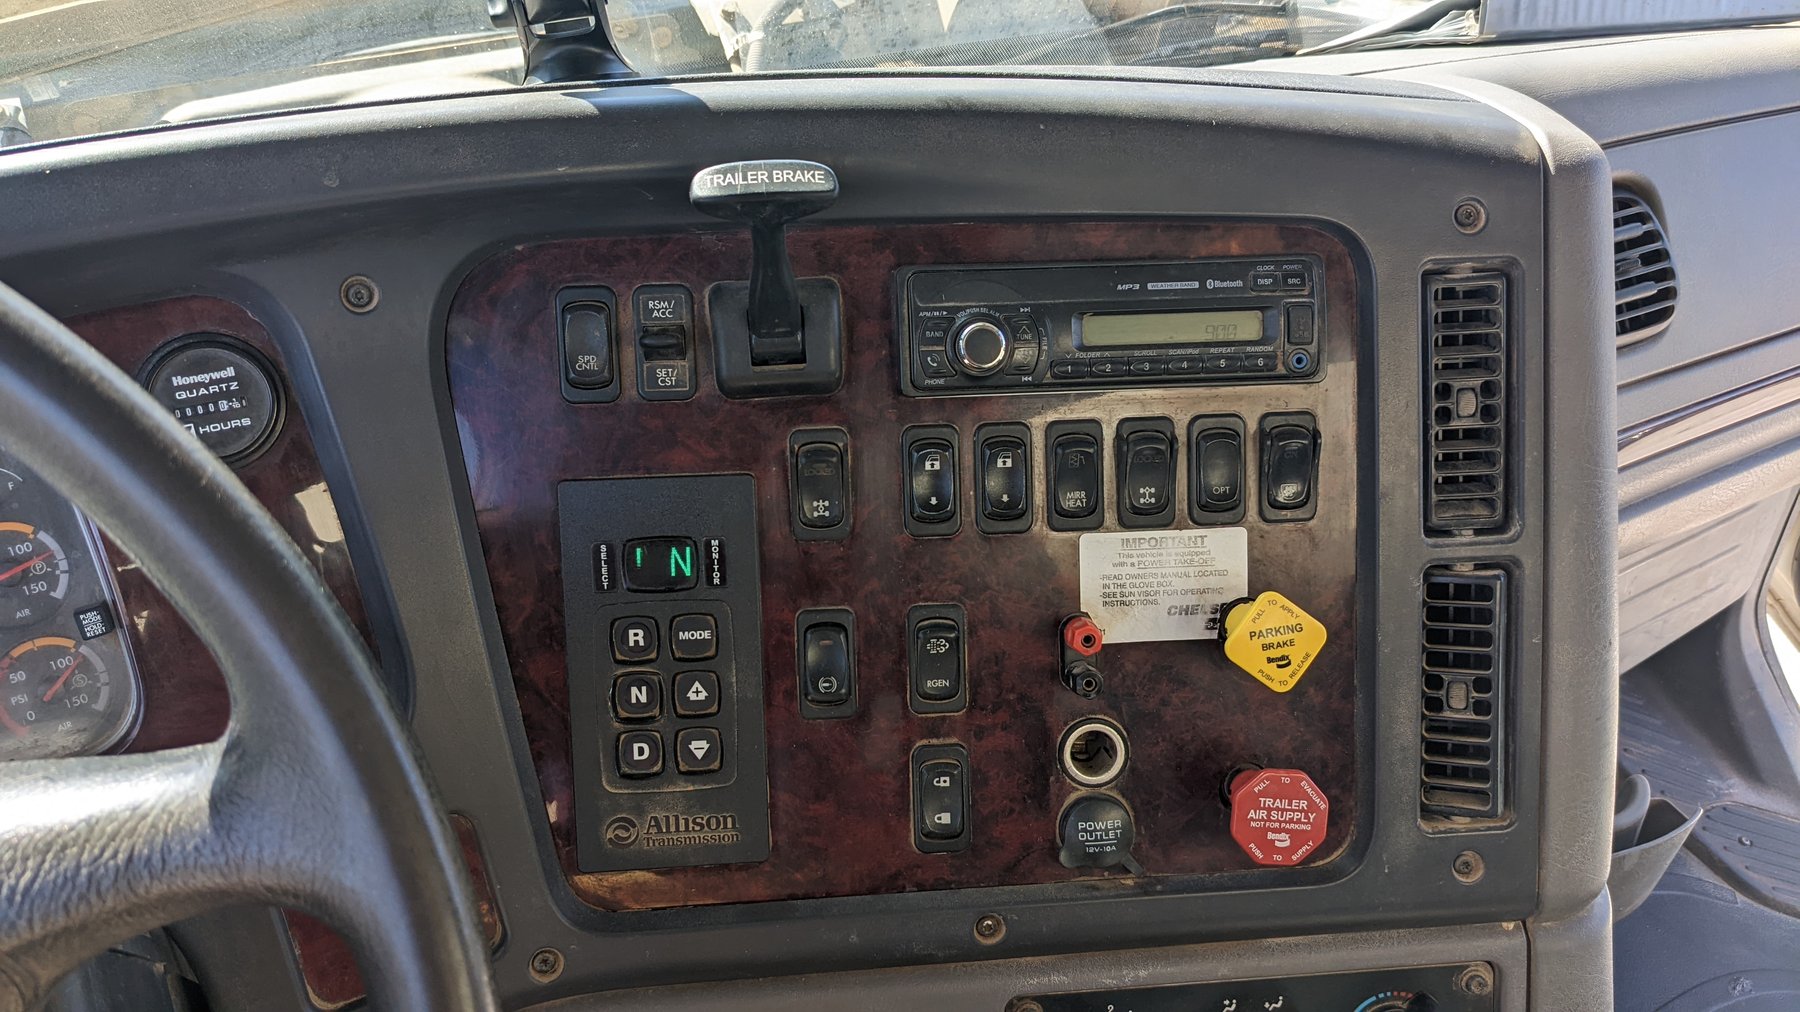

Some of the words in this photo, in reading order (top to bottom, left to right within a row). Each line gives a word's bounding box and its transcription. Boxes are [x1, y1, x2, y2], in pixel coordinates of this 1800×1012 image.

[705, 171, 769, 188] TRAILER
[773, 170, 826, 184] BRAKE
[1116, 283, 1140, 291] MP3
[1180, 281, 1197, 289] BAND
[1214, 279, 1244, 288] Bluetooth
[1257, 278, 1273, 286] DISP
[1287, 277, 1301, 286] SRC
[649, 300, 675, 310] RSM/
[652, 309, 674, 318] ACC
[578, 355, 597, 363] SPD
[1220, 359, 1226, 367] 5
[1257, 358, 1264, 366] 6
[576, 362, 599, 371] CNTL
[1067, 365, 1072, 373] 1
[1105, 364, 1111, 372] 2
[1143, 362, 1149, 370] 3
[1181, 361, 1187, 369] 4
[172, 366, 236, 386] Honeywell
[656, 368, 677, 378] SET/
[658, 377, 677, 386] CST
[175, 382, 239, 399] QUARTZ
[199, 418, 251, 435] HOURS
[8, 481, 15, 491] F
[1212, 486, 1230, 495] OPT
[1066, 491, 1086, 499] MIRR
[1065, 499, 1087, 508] HEAT
[1120, 535, 1208, 548] IMPORTANT
[7, 542, 33, 557] 100
[600, 544, 609, 590] SELECT
[670, 546, 691, 577] N
[711, 539, 721, 586] MONITOR
[1112, 560, 1129, 568] with
[1138, 559, 1172, 567] POWER
[1174, 557, 1216, 566] TAKE-OFF
[1125, 572, 1158, 580] OWNERS
[1161, 571, 1192, 579] MANUAL
[1193, 569, 1229, 578] LOCATED
[22, 581, 47, 596] 150
[1129, 581, 1155, 589] GLOVE
[1102, 598, 1160, 608] INSTRUCTIONS.
[16, 608, 31, 619] AIR
[1252, 608, 1266, 624] PULL
[1280, 604, 1300, 620] APPLY
[82, 614, 102, 625] MODE
[86, 627, 106, 638] RESET
[679, 630, 712, 640] MODE
[1249, 623, 1304, 641] PARKING
[628, 629, 645, 647] R
[1261, 638, 1296, 652] BRAKE
[50, 656, 74, 671] 100
[1266, 654, 1290, 664] Bendix
[1257, 669, 1275, 683] PUSH
[1289, 651, 1312, 679] RELEASE
[9, 671, 26, 684] 50
[927, 679, 950, 688] RGEN
[11, 693, 28, 706] PSI
[630, 685, 647, 704] N
[64, 694, 89, 708] 150
[26, 711, 36, 721] 0
[58, 721, 73, 732] AIR
[632, 742, 650, 761] D
[1253, 779, 1270, 794] PULL
[1300, 780, 1327, 810] EVACUATE
[1259, 797, 1308, 810] TRAILER
[1247, 809, 1267, 820] AIR
[1270, 811, 1316, 822] SUPPLY
[643, 813, 740, 835] Allison
[1078, 819, 1122, 831] POWER
[1281, 823, 1311, 831] PARKING
[643, 833, 741, 848] Transmission
[1078, 829, 1122, 841] OUTLET
[1267, 832, 1291, 841] Bendix
[1086, 845, 1117, 853] 12V-10A
[1248, 843, 1264, 860] PUSH
[1291, 840, 1314, 861] SUPPLY
